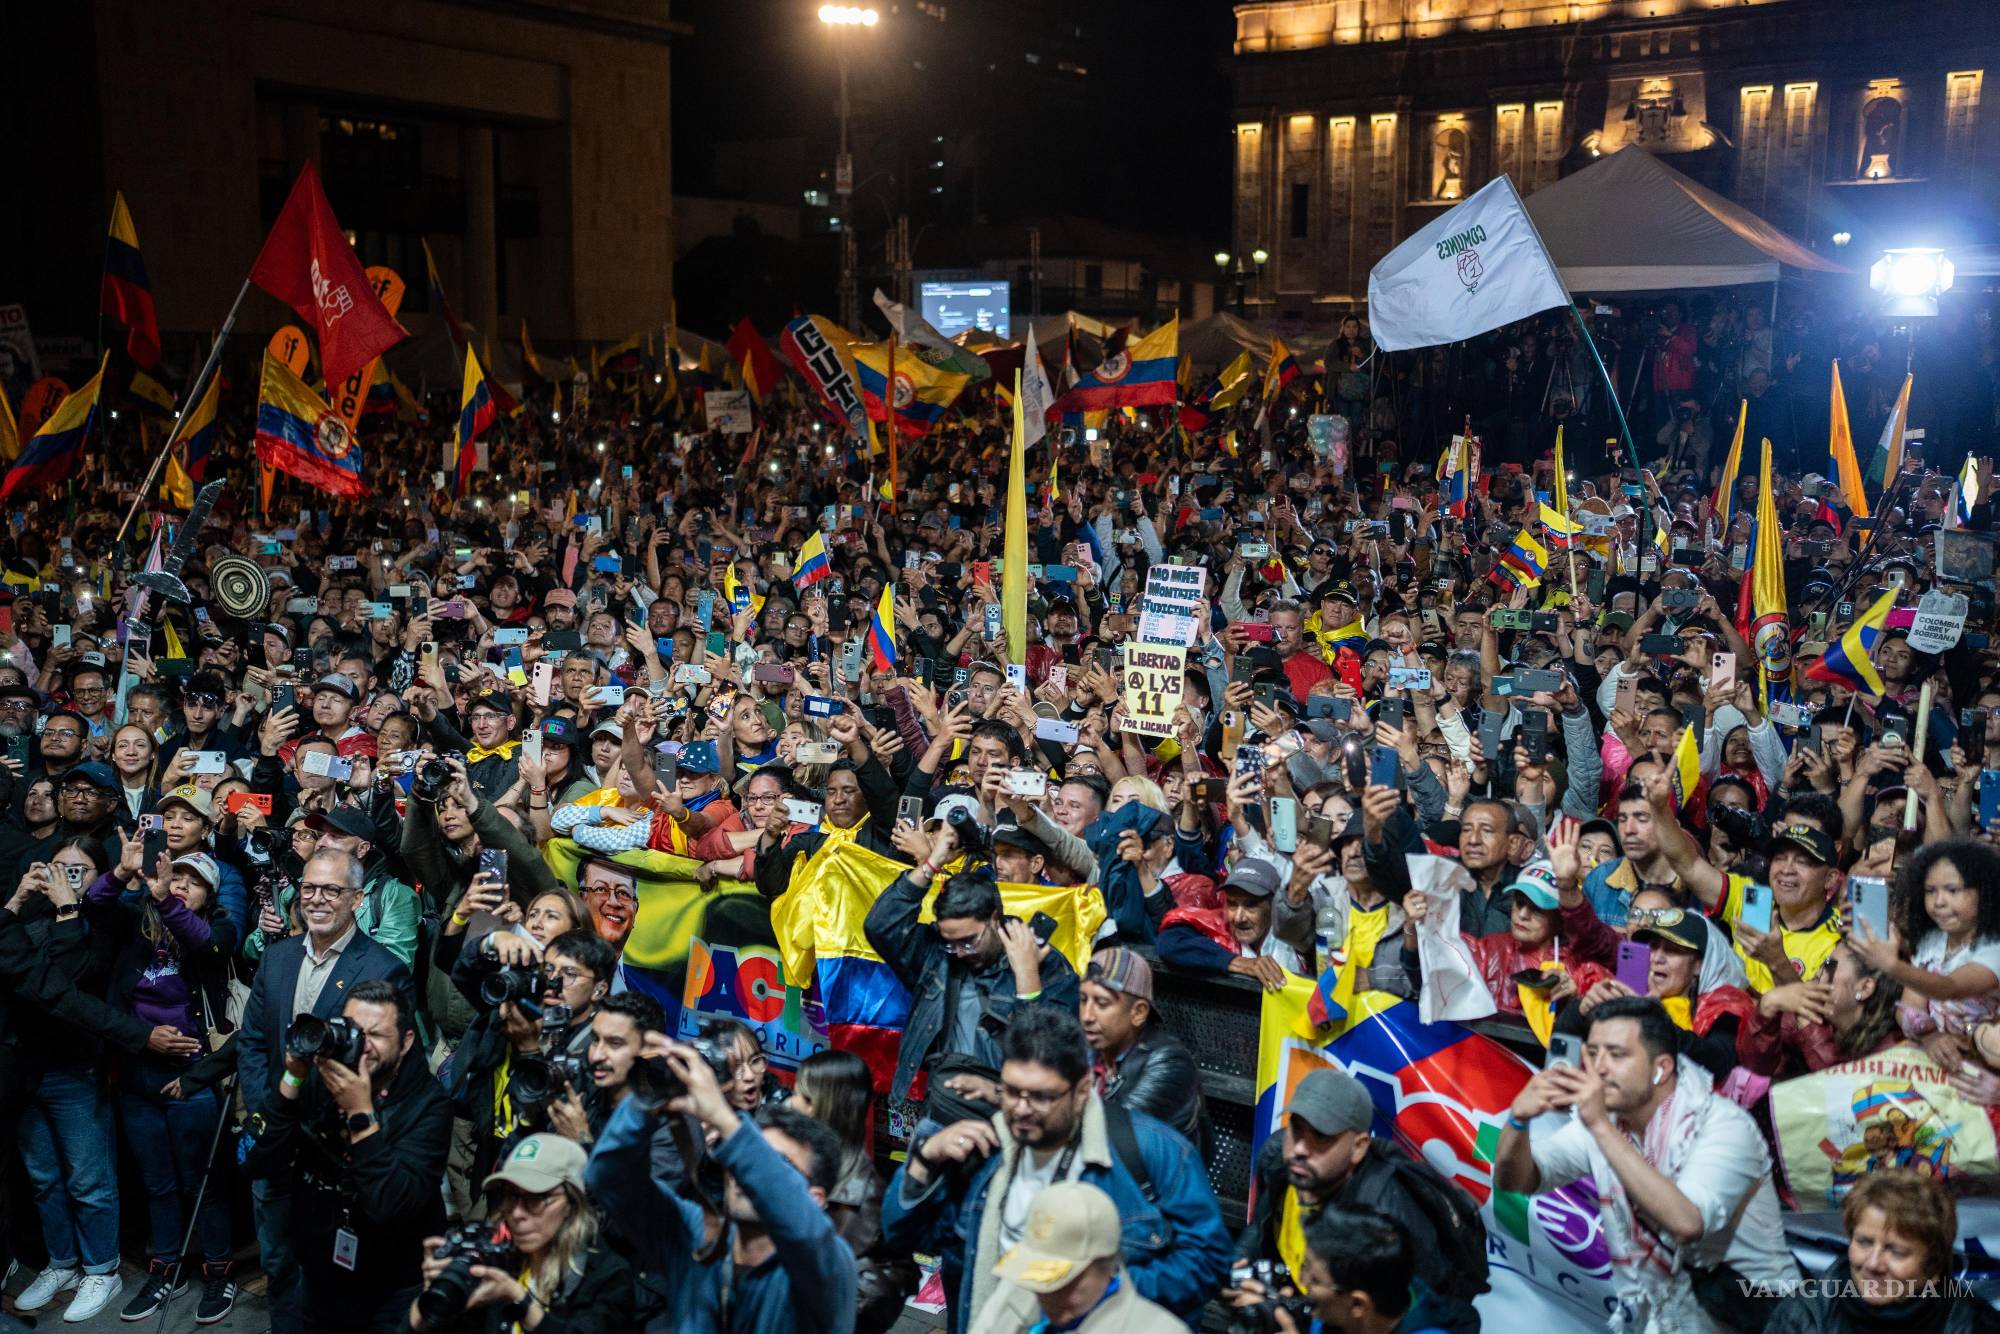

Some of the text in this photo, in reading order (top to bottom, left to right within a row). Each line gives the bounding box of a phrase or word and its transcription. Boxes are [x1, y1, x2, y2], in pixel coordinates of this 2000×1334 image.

[1149, 567, 1199, 585] NO MÁS
[1918, 616, 1960, 629] COLOMBIA
[1923, 624, 1951, 634] LIBRE Y
[1913, 629, 1956, 642] SOBERANA
[1128, 648, 1181, 671] LIBERTAD
[1136, 691, 1165, 716] 11
[1123, 717, 1173, 735] POR LUCHAR
